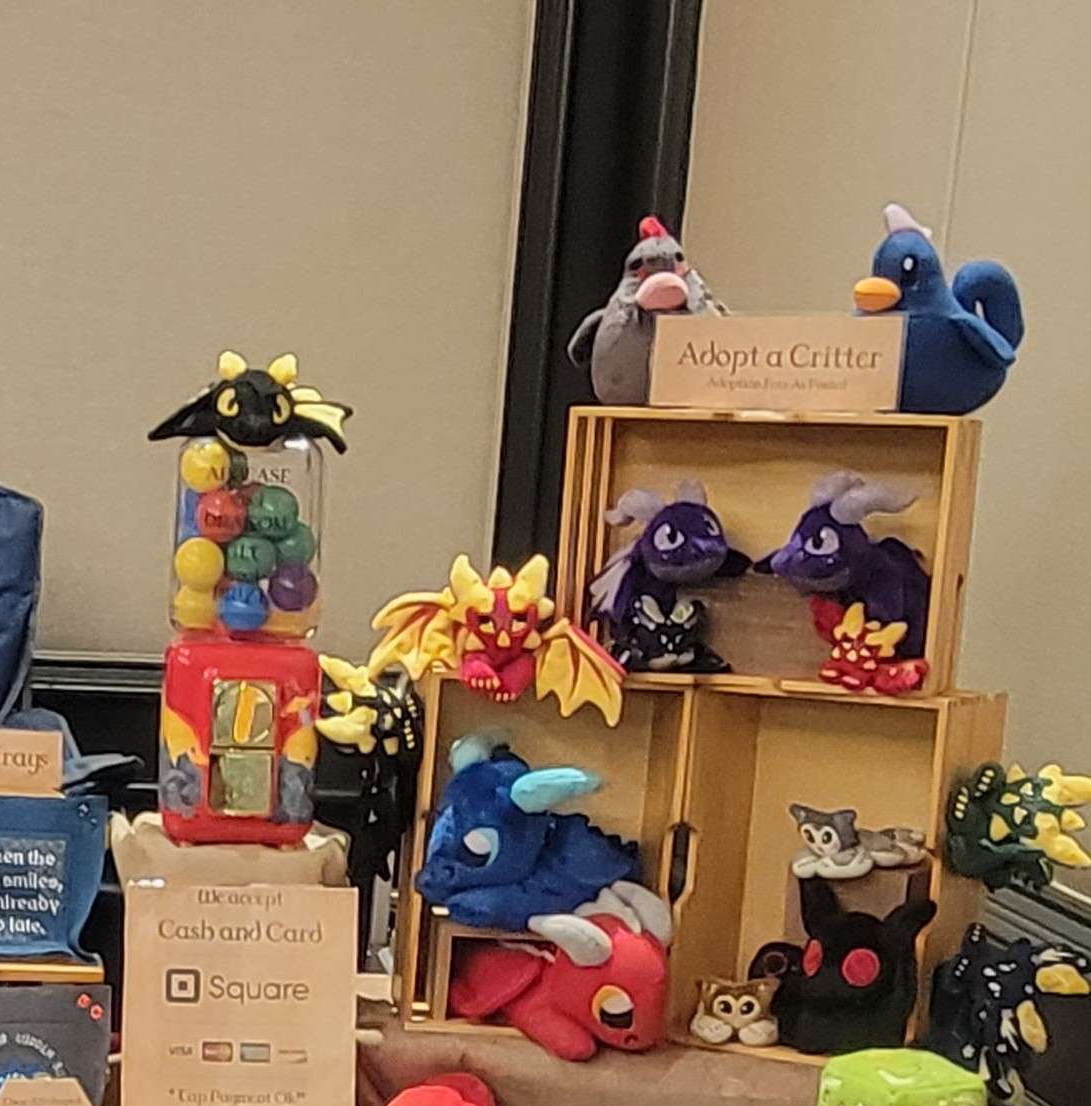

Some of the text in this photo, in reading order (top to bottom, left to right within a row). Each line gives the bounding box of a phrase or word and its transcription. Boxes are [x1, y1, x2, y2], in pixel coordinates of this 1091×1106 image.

[677, 340, 882, 376] Adopt a Critter
[27, 848, 57, 867] the
[227, 892, 283, 912] accept
[158, 918, 323, 944] Cash and Card
[208, 974, 310, 1005] Square
